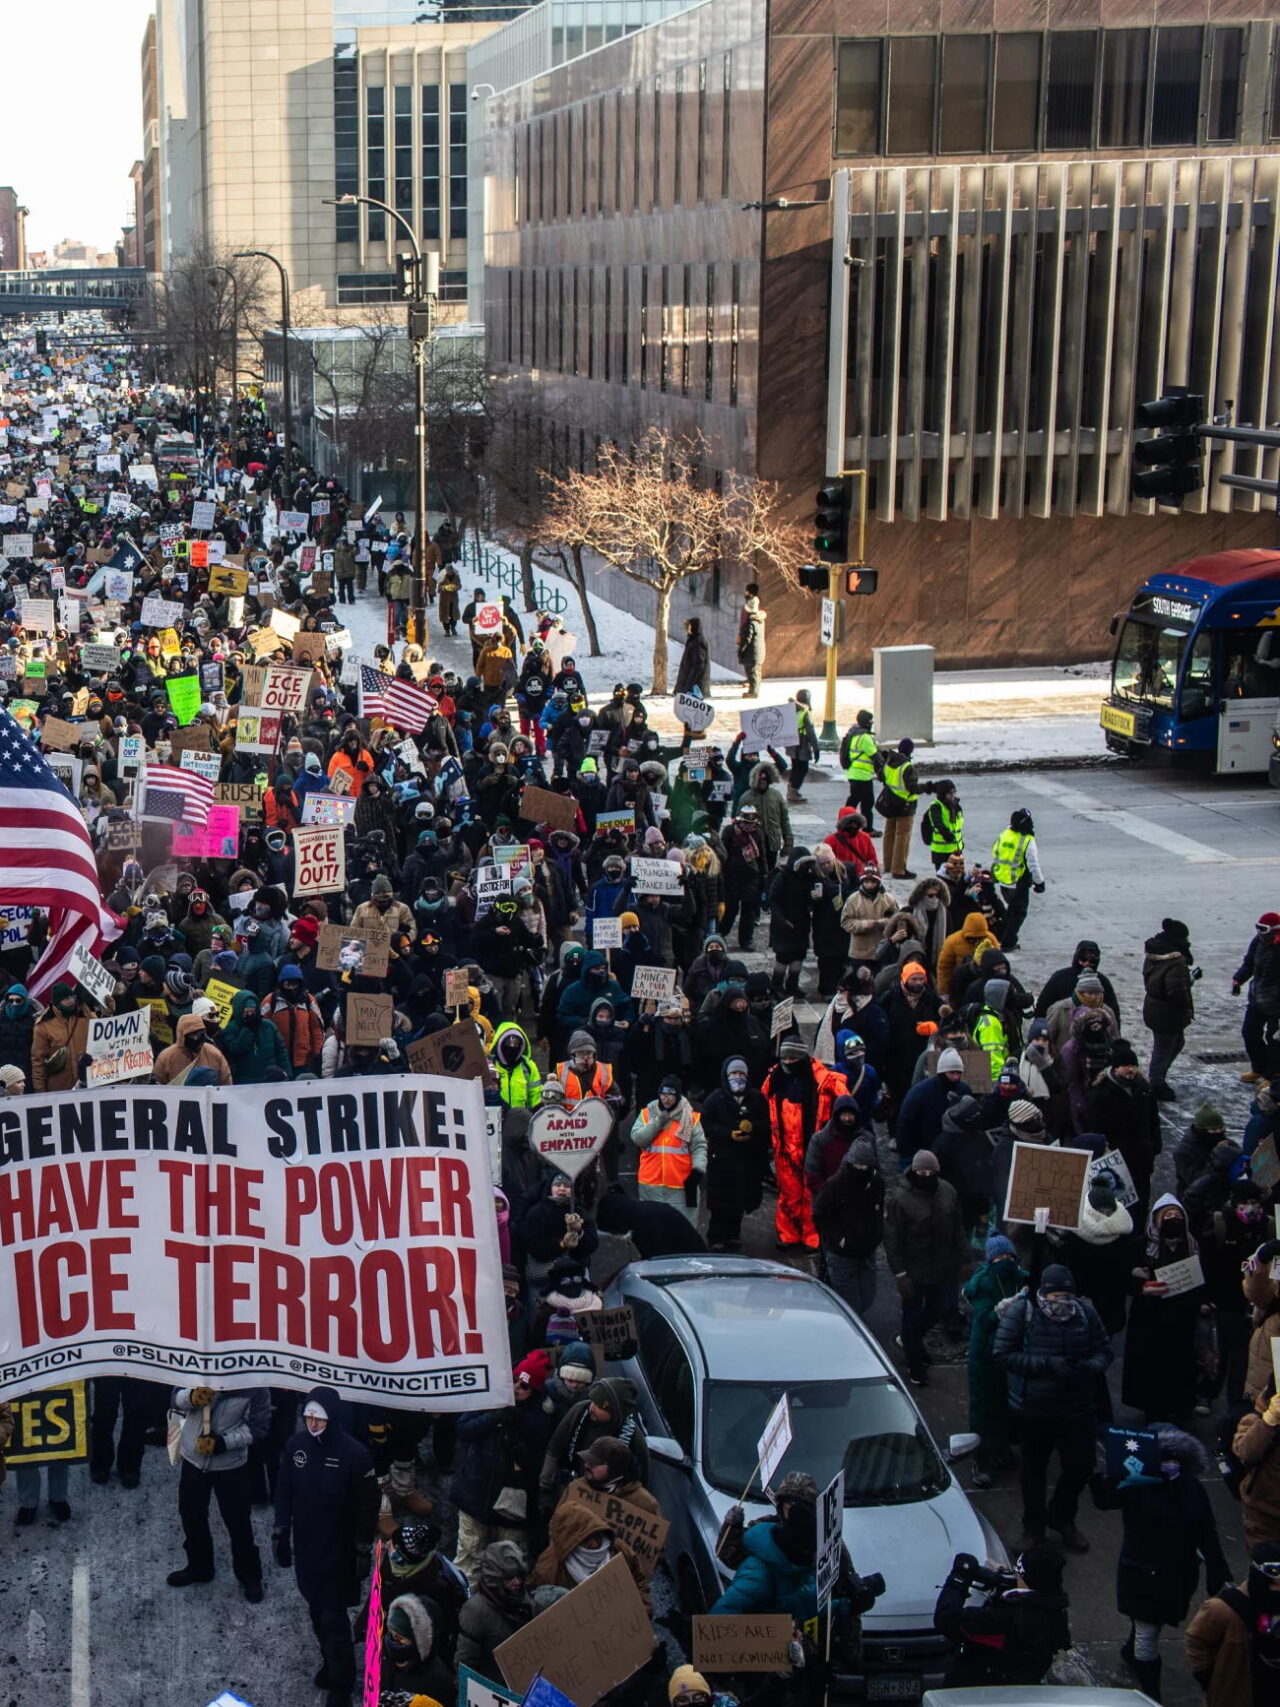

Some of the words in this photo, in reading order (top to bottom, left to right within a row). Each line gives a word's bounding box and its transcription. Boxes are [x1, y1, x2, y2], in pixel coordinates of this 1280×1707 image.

[1153, 597, 1170, 616] SOUTH
[269, 675, 303, 692] ICE
[265, 691, 302, 710] OUT!
[124, 739, 140, 748] ICE
[300, 842, 337, 866] ICE
[300, 863, 340, 886] OUT!
[479, 881, 499, 894] JUSTICE
[499, 879, 510, 889] FOR
[75, 944, 115, 991] ABOLISH
[79, 969, 99, 995] ICE
[360, 1007, 376, 1018] MN
[93, 1014, 141, 1041] DOWN
[109, 1038, 130, 1050] WITH
[132, 1036, 144, 1045] THE
[264, 1090, 467, 1159] STRIKE:
[547, 1118, 588, 1131] ARMED
[540, 1136, 598, 1152] EMPATHY
[159, 1159, 266, 1239] THE
[284, 1156, 475, 1248] POWER
[13, 1237, 135, 1348] ICE
[165, 1239, 484, 1364] TERROR!
[112, 1343, 284, 1371] @PSLNATIONAL
[289, 1358, 478, 1391] @PSLTWINCITIES
[577, 1486, 602, 1504] THE
[605, 1497, 660, 1537] PEOPLE
[592, 1614, 645, 1664] NOW
[697, 1621, 738, 1641] KIDS
[744, 1623, 777, 1639] ARE
[503, 1624, 563, 1676] BRING
[699, 1654, 722, 1666] NOT
